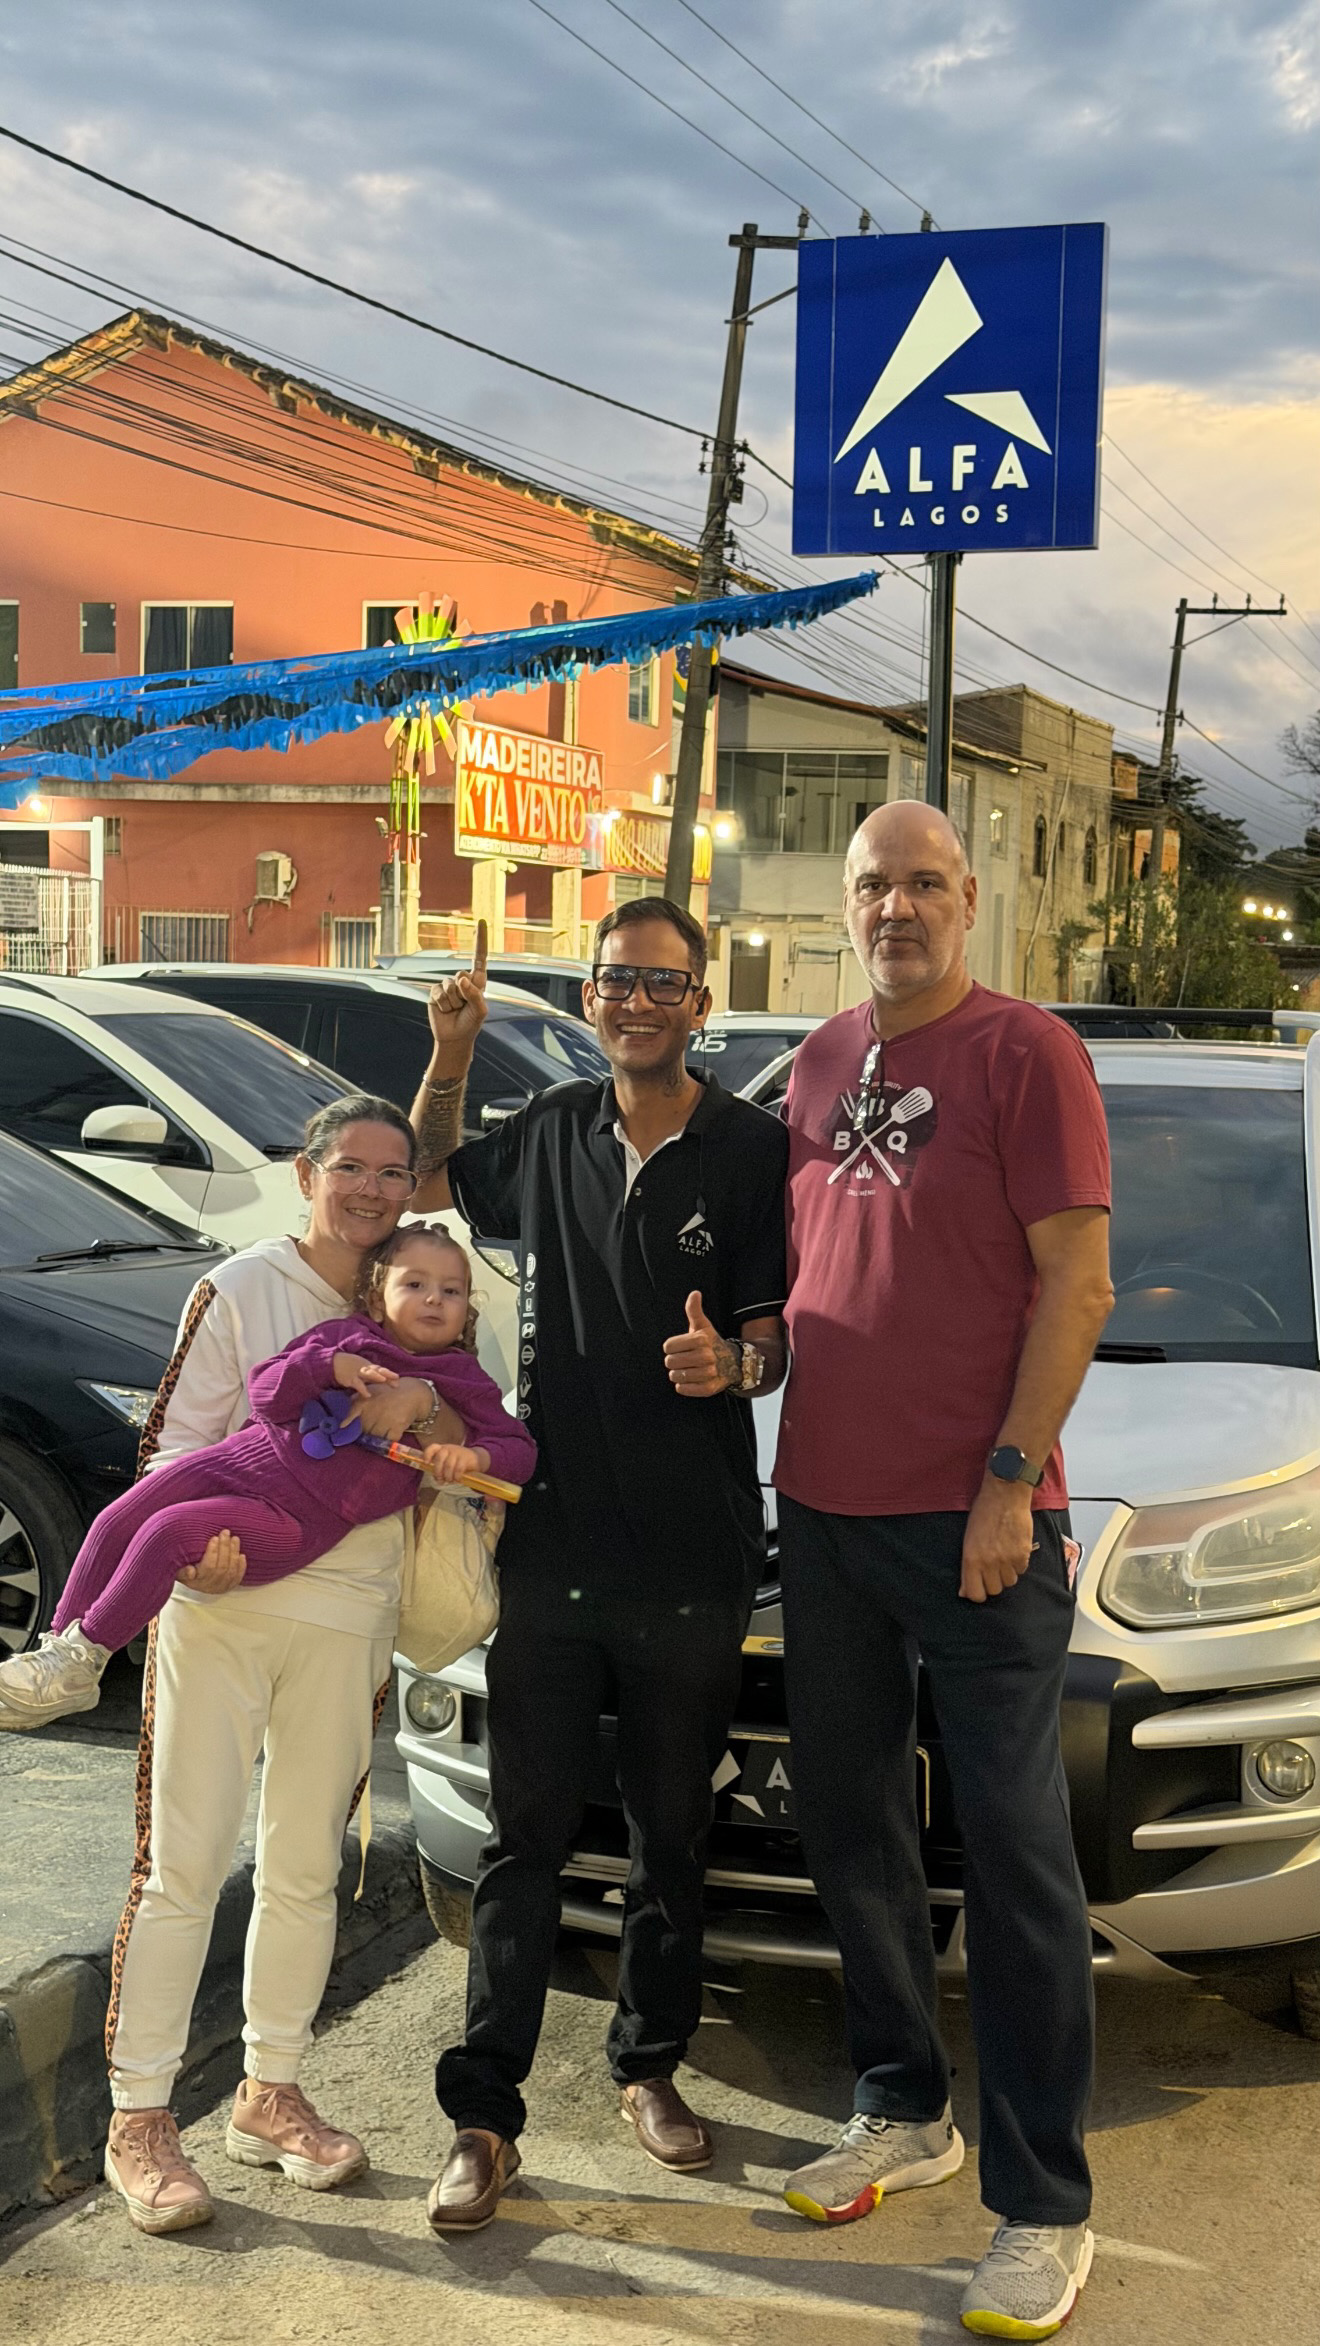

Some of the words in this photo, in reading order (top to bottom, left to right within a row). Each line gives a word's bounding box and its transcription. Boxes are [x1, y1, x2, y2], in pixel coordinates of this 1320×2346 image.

[854, 441, 1029, 495] ALFA
[873, 504, 1009, 528] LAGOS
[460, 726, 602, 791] MADEIREIRA
[459, 768, 510, 835] K'TA
[513, 780, 586, 845] VENTO
[678, 1235, 710, 1252] ALFA
